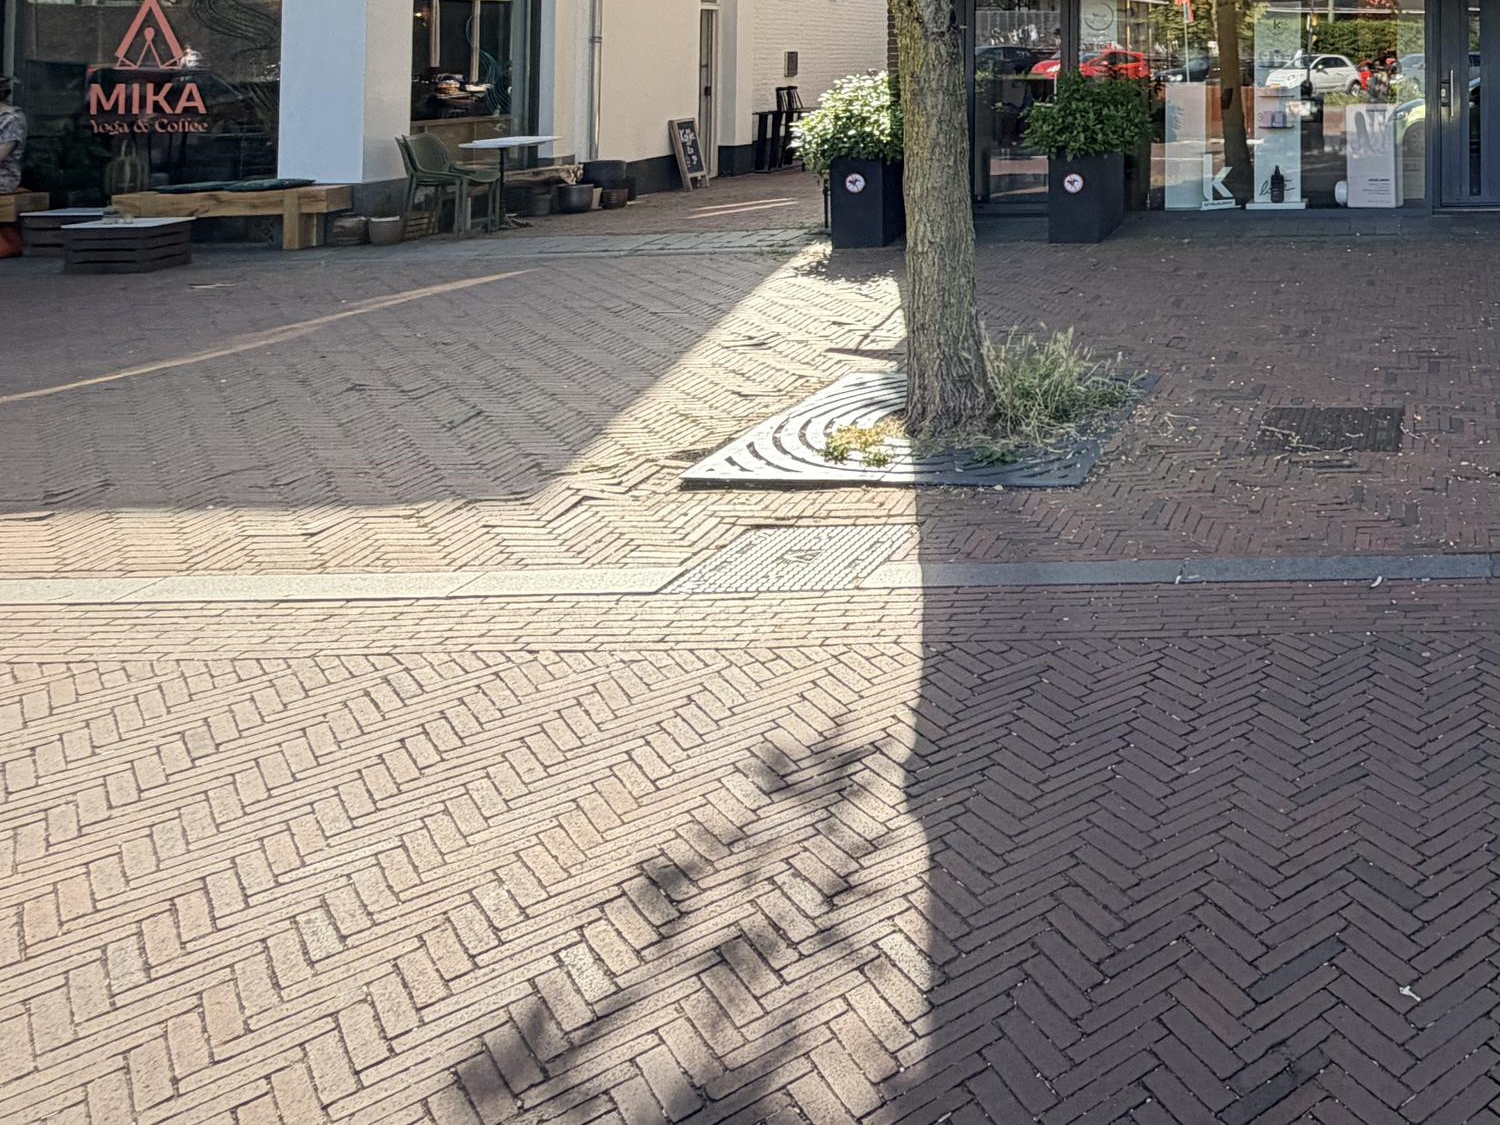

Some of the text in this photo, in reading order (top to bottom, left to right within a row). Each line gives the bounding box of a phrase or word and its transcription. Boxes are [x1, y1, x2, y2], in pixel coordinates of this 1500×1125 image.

[89, 82, 207, 115] MIKA
[89, 117, 209, 135] Yoga & Coffee
